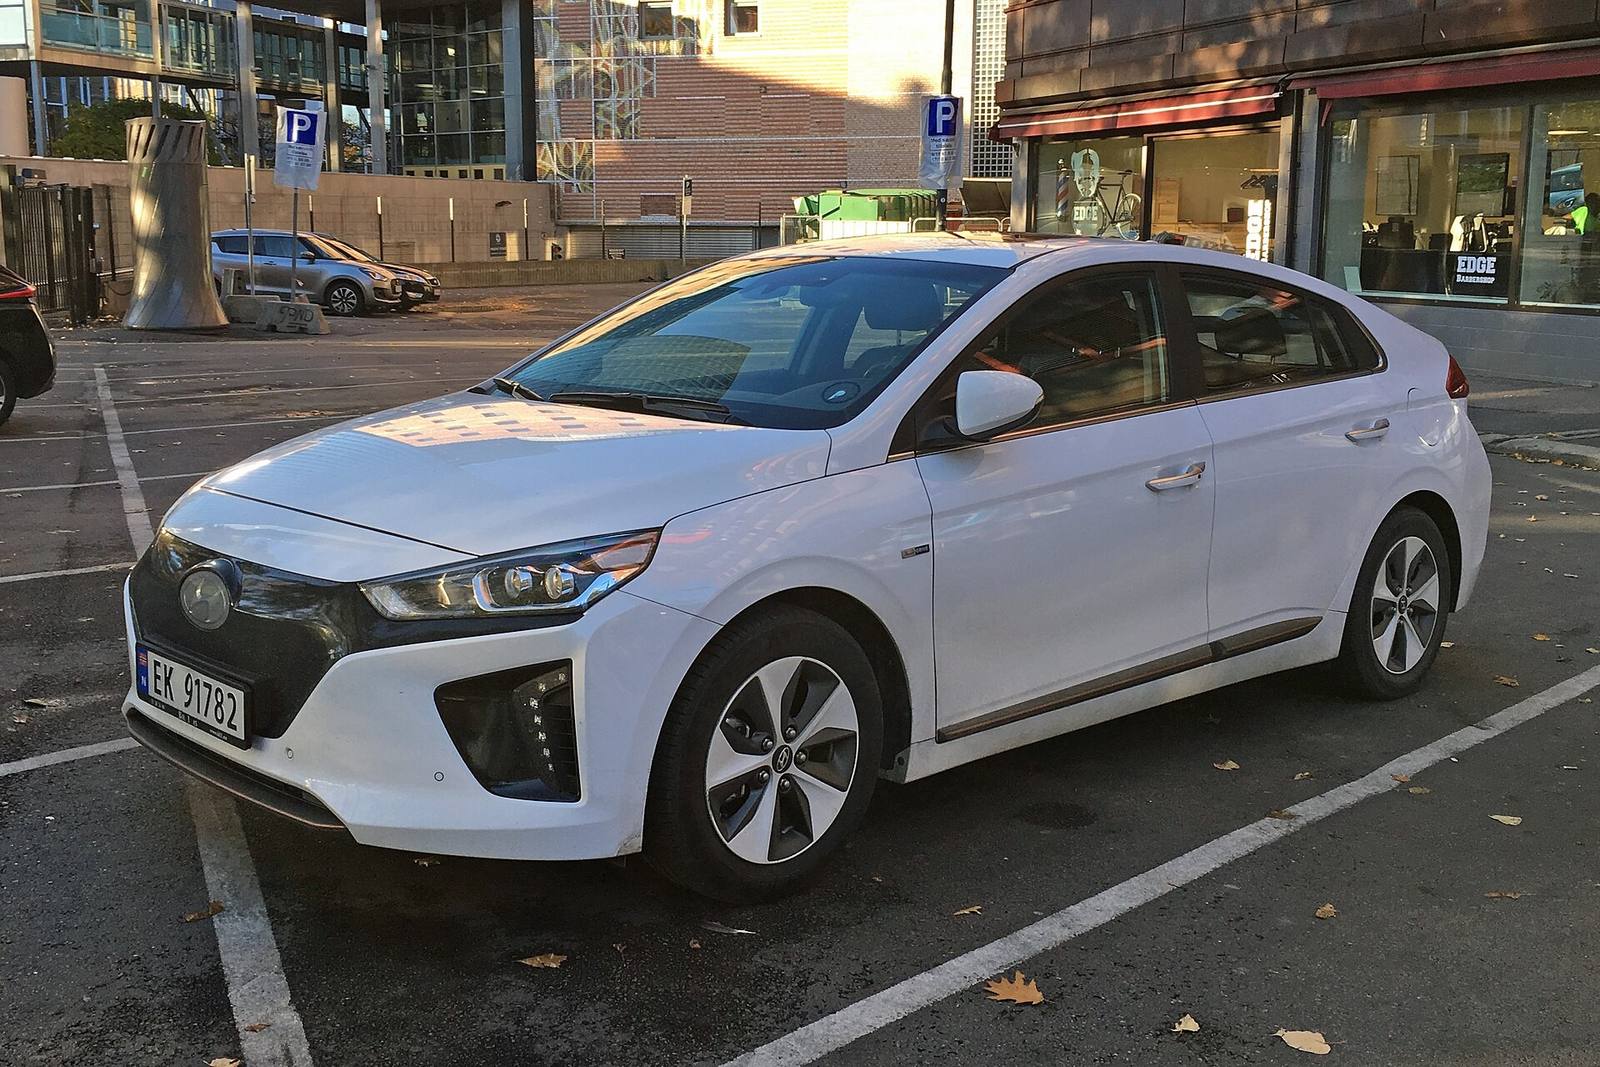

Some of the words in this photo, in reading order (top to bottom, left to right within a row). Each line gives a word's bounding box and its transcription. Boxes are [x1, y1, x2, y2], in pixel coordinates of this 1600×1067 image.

[291, 113, 312, 144] P
[936, 101, 955, 134] P
[1073, 206, 1099, 221] EDGE
[1457, 256, 1496, 274] EDGE
[153, 660, 174, 702] EK
[184, 672, 238, 732] 91782
